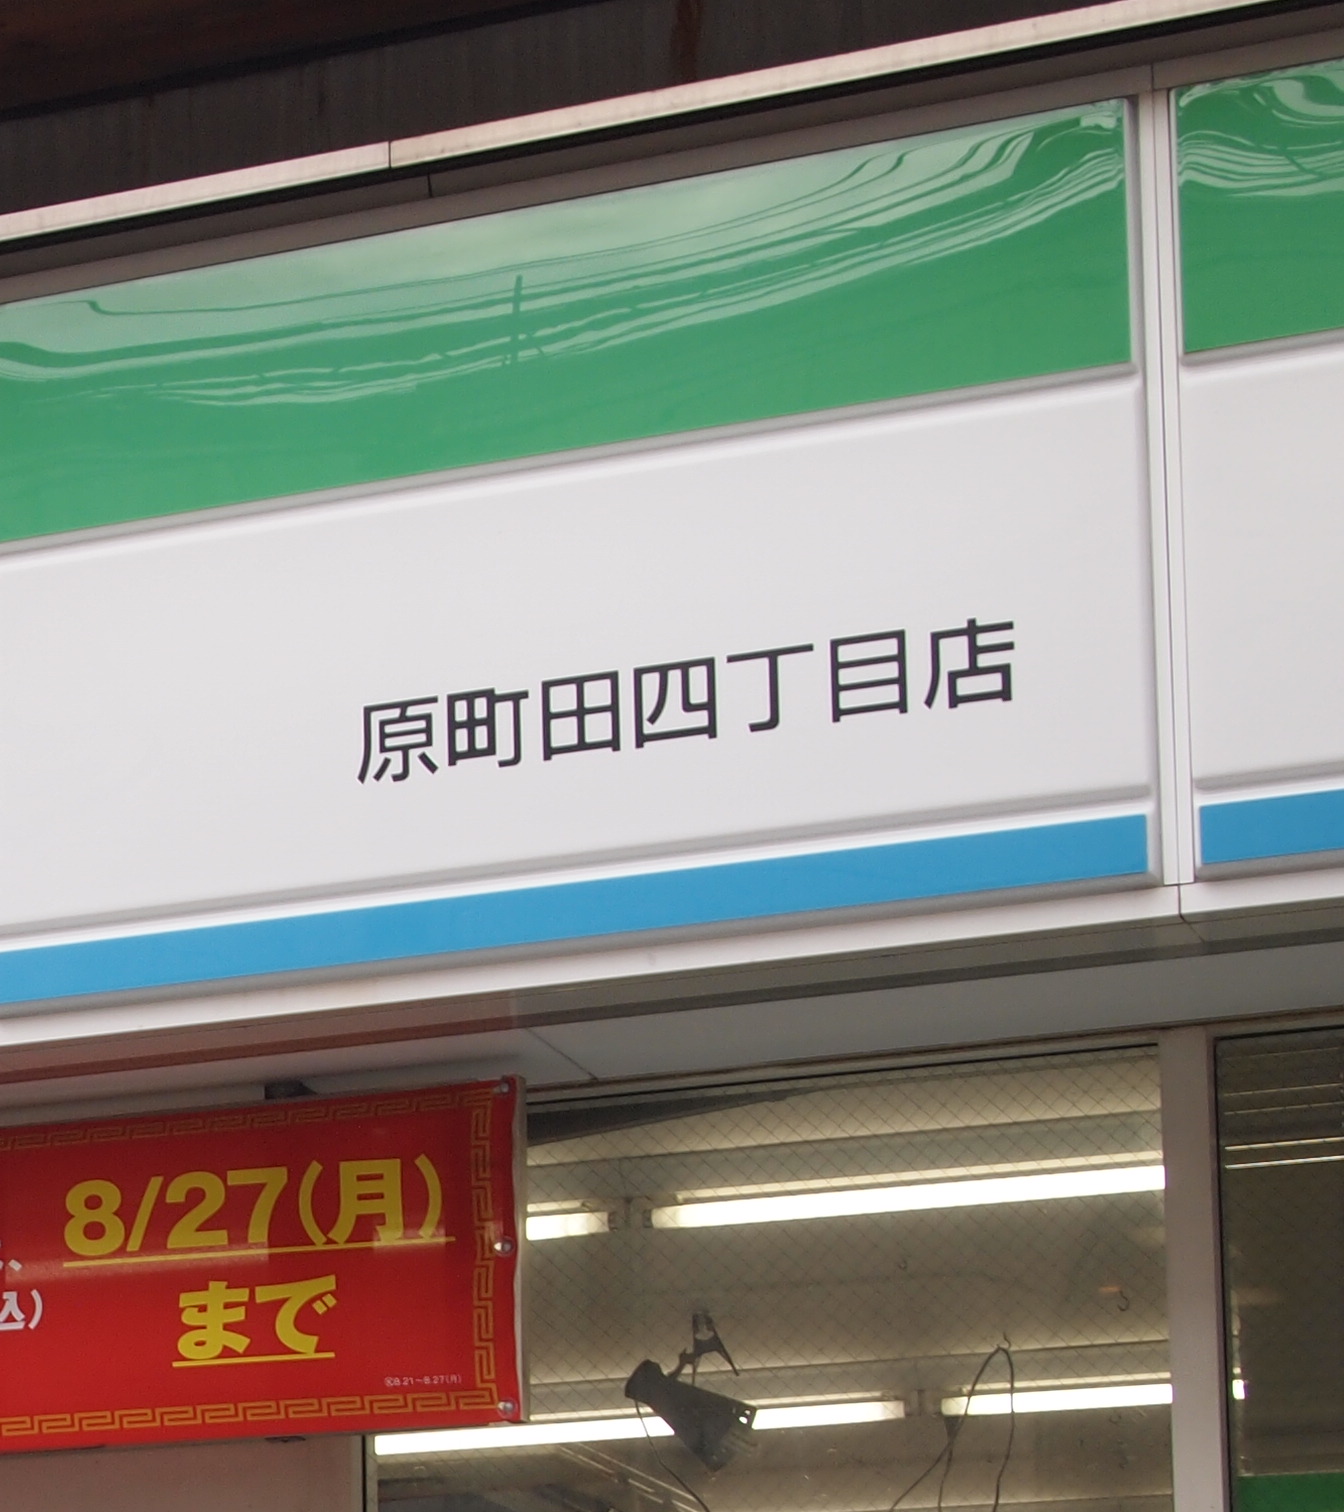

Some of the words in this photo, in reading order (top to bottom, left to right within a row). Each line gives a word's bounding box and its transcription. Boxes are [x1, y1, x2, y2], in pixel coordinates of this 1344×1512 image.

[356, 617, 1016, 785] 原町田四丁目店
[63, 1154, 445, 1260] 8/27(月)
[175, 1274, 337, 1362] まで
